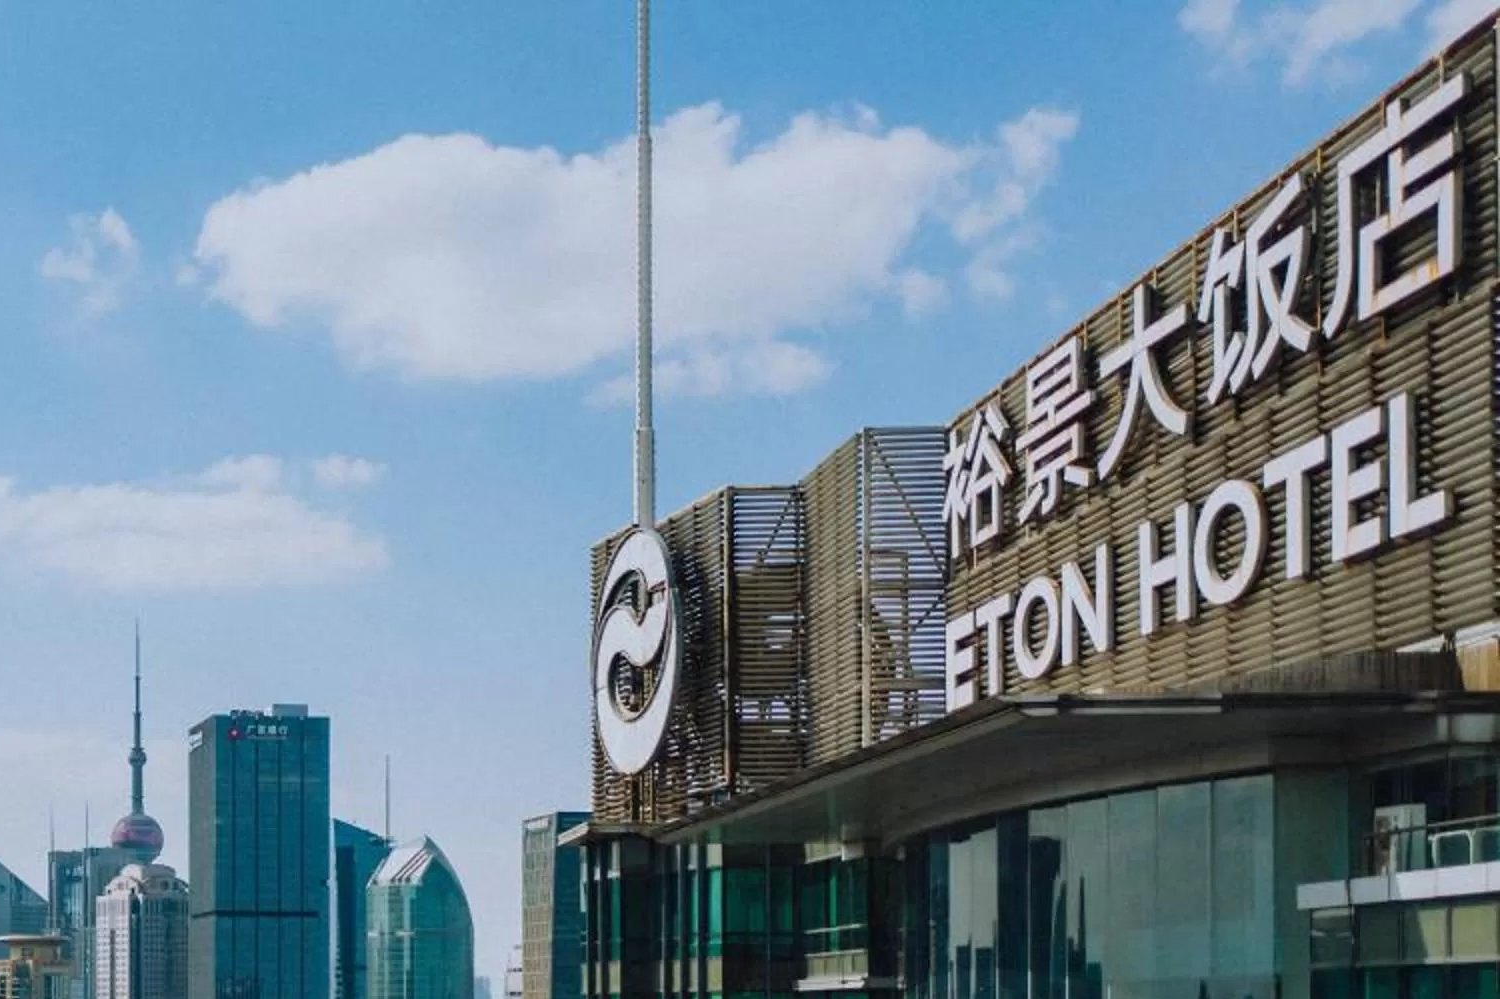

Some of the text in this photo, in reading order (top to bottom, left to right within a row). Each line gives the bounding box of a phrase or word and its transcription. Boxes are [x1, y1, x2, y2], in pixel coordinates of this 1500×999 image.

[942, 73, 1470, 558] 裕景大饭店
[946, 391, 1454, 712] ETON HOTEL
